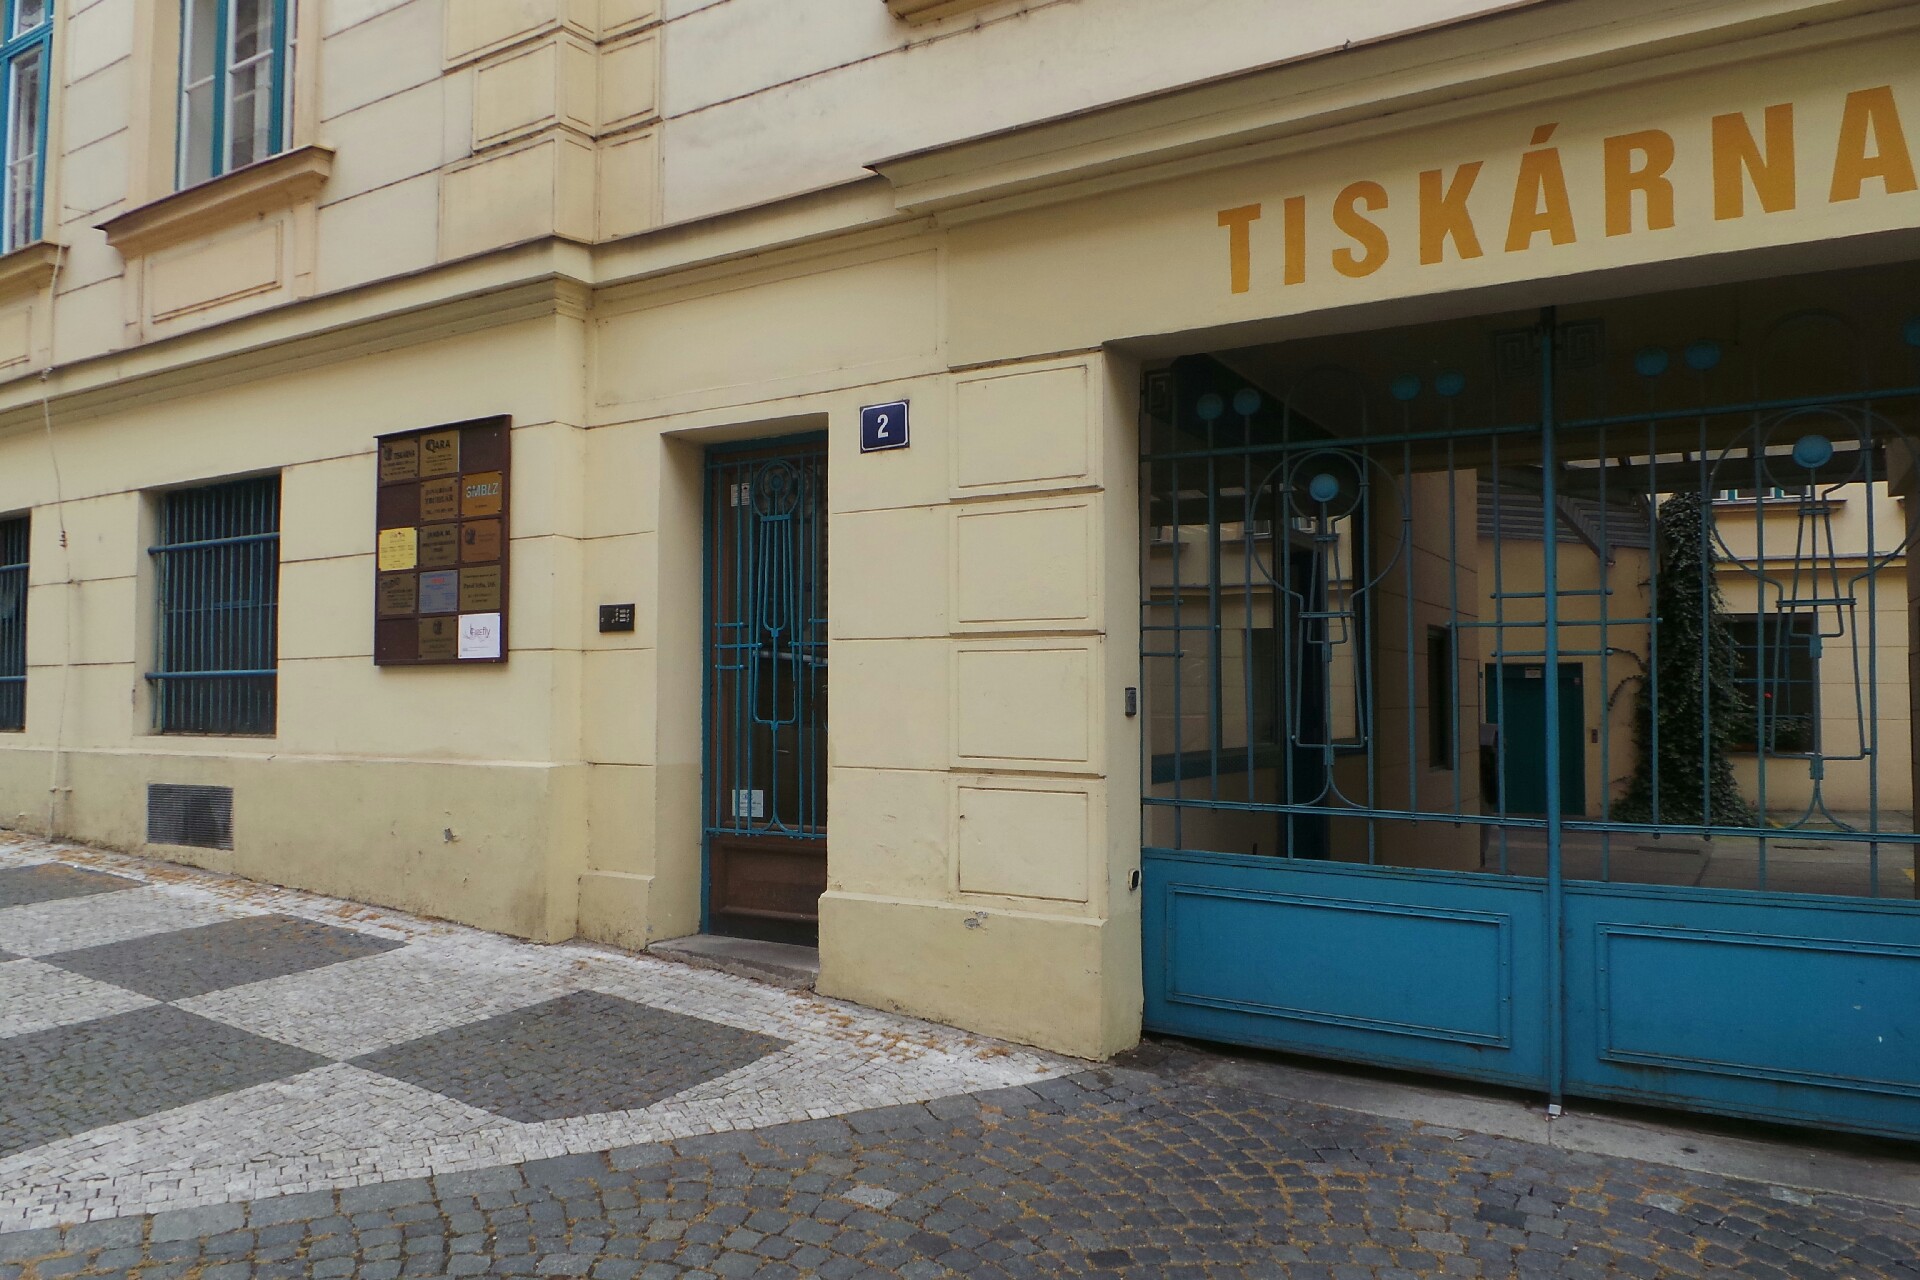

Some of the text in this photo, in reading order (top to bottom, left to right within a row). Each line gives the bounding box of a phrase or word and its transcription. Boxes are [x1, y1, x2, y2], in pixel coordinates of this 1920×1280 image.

[1217, 85, 1919, 295] TISKÁRNA
[877, 414, 889, 439] 2
[425, 438, 451, 453] QARA
[465, 482, 499, 499] SMBLZ
